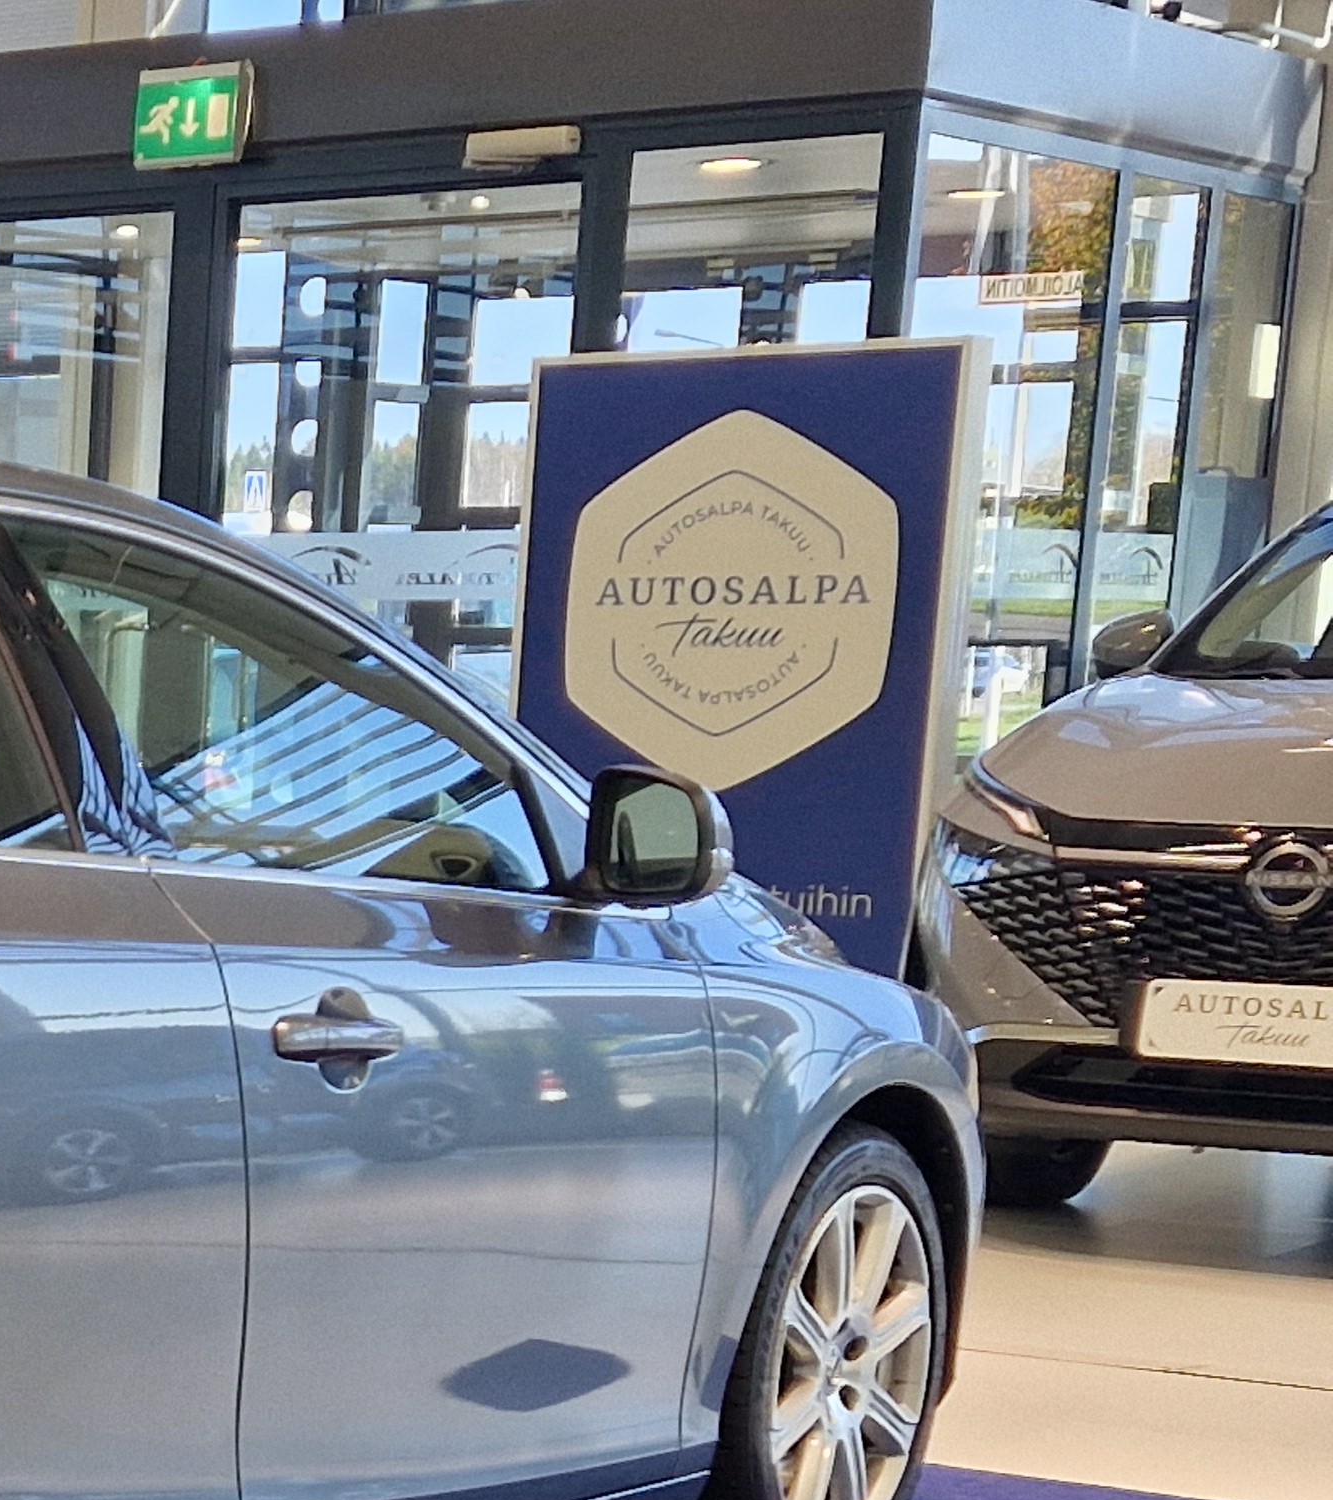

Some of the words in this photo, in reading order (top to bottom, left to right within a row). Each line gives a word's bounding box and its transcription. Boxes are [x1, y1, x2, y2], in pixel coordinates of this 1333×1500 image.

[653, 500, 754, 557] AUTOSALPA
[760, 505, 811, 553] TAKUU
[596, 574, 872, 606] AUTOSALPA
[655, 612, 786, 657] Takuu
[642, 652, 692, 705] TAKUU
[699, 650, 801, 705] AUTOSALPA
[1245, 869, 1332, 888] NISSAN
[1173, 993, 1331, 1020] AUTOSAL
[1216, 1022, 1313, 1048] Takuu
